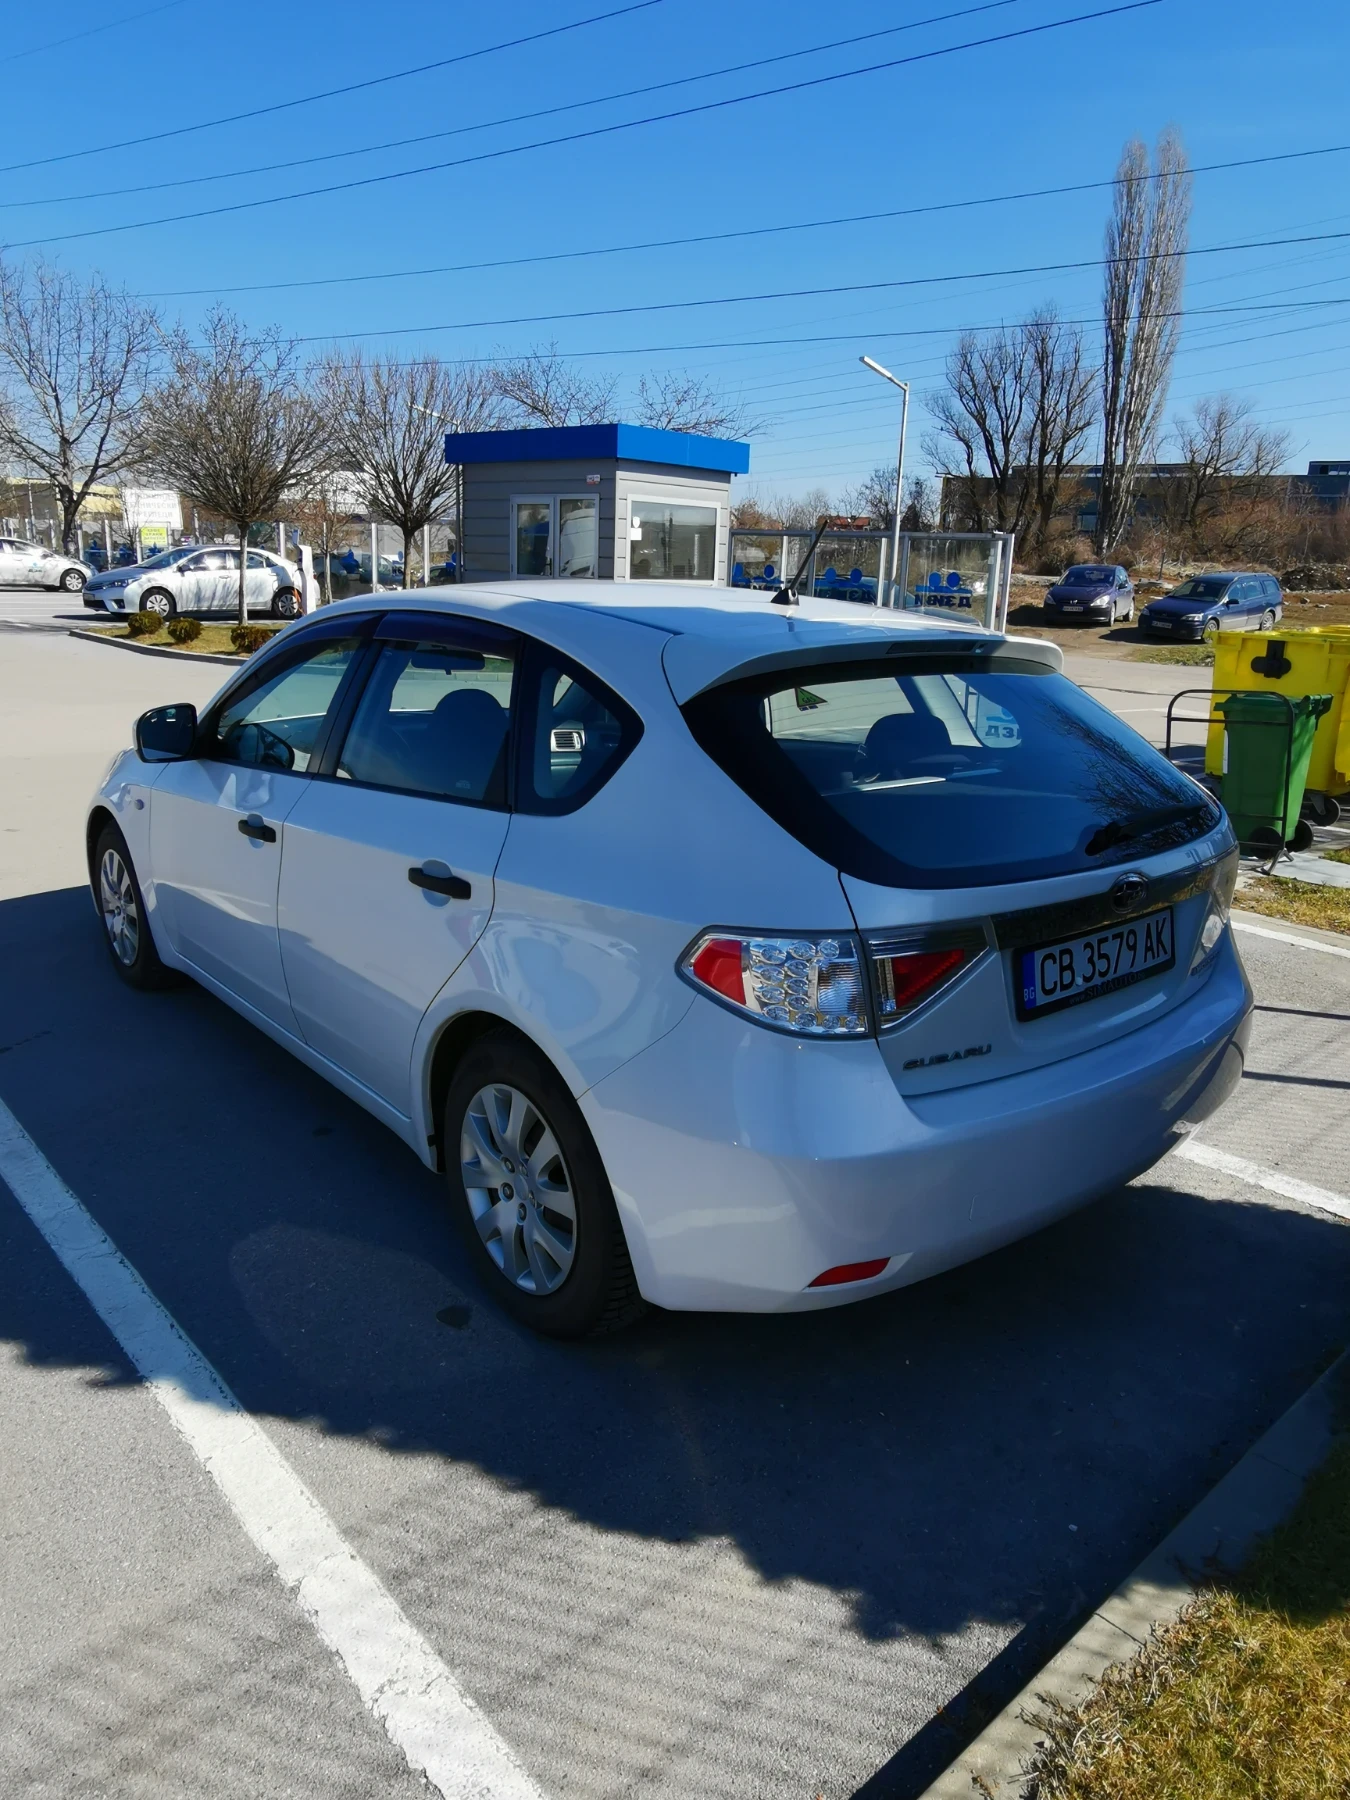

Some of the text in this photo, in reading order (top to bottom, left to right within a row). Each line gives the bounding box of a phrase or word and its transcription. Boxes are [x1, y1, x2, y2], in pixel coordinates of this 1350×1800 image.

[1040, 948, 1076, 996] CB
[1082, 929, 1138, 984] 3579
[1143, 917, 1168, 963] AK
[1023, 986, 1035, 1001] BG
[903, 1043, 991, 1070] SUBARU
